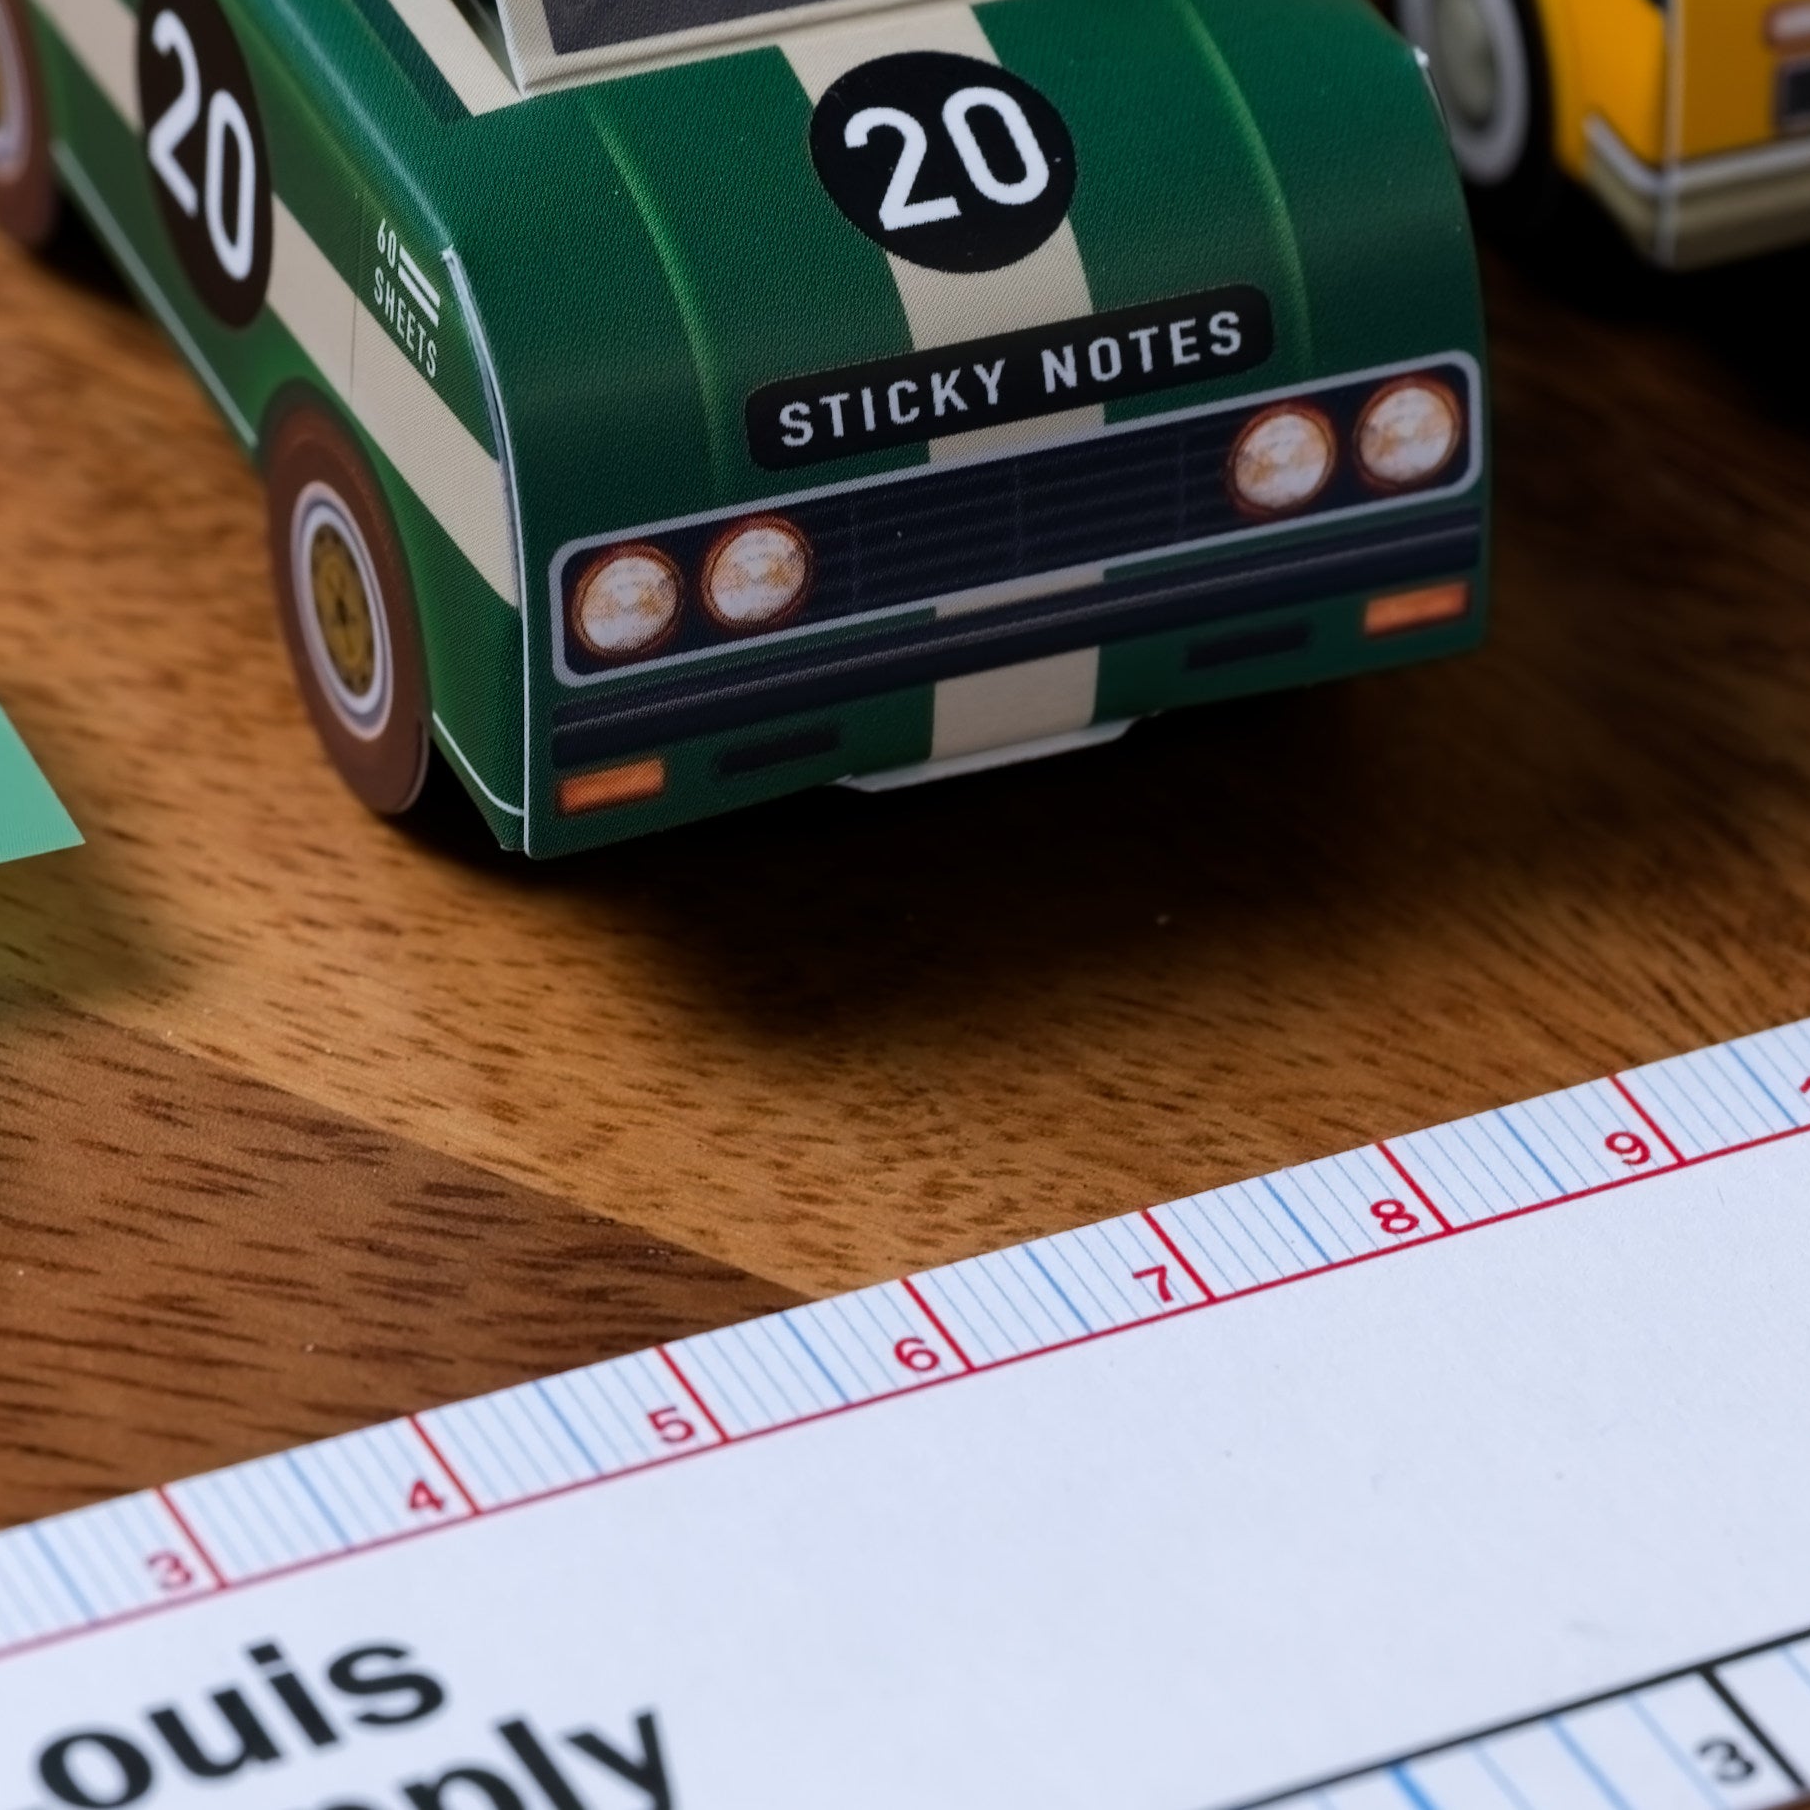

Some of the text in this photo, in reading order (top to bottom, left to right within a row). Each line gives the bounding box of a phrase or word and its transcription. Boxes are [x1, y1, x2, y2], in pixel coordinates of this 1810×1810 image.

[147, 7, 257, 283] 20
[843, 86, 1050, 231] 20
[376, 217, 398, 270] 60
[372, 266, 438, 379] SHEETS
[778, 311, 1243, 448] STICKY NOTES
[147, 1553, 193, 1589] 3
[406, 1479, 445, 1511] 4
[648, 1406, 696, 1444] 5
[893, 1336, 941, 1373] 6
[1132, 1265, 1174, 1302] 7
[1370, 1199, 1419, 1234] 8
[1604, 1131, 1651, 1166] 9
[1695, 1734, 1758, 1785] 3
